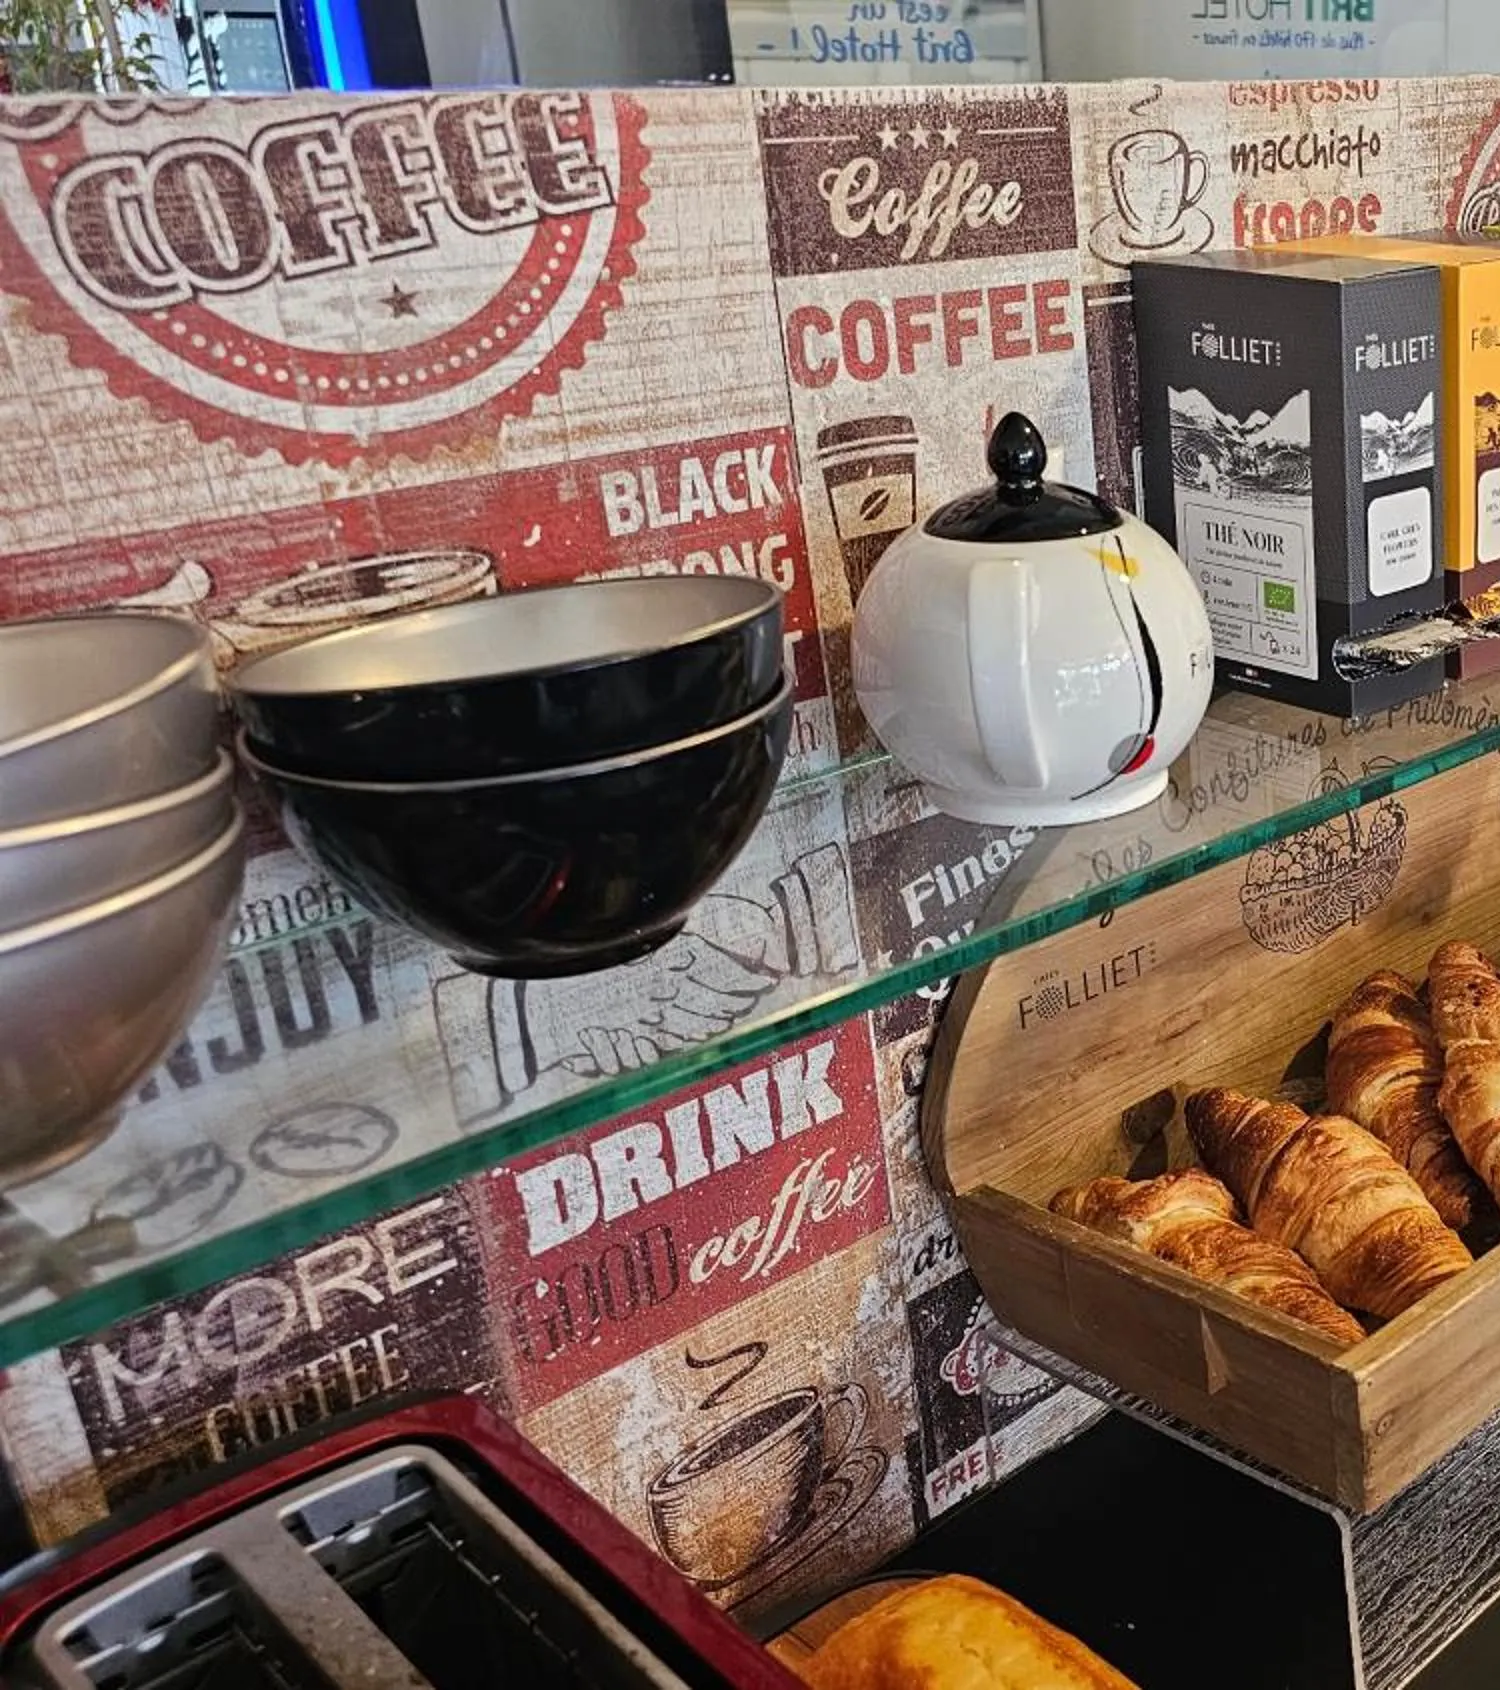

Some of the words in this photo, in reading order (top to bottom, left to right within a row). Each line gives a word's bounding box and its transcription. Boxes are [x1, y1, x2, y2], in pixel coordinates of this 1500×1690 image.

[1231, 124, 1382, 178] macchiato
[52, 93, 616, 311] COFFEE
[818, 156, 1023, 260] Coffee
[785, 279, 1075, 390] COFFEE
[1191, 331, 1273, 367] FOLLIET
[1355, 335, 1428, 372] FOLLIET
[600, 444, 785, 537] BLACK
[1202, 521, 1239, 546] THÉ
[1242, 526, 1286, 557] NOIR
[1018, 945, 1146, 1030] FOLLIET
[515, 1040, 845, 1257] DRINK
[688, 1146, 881, 1284] coffee
[90, 1198, 458, 1424] MORE
